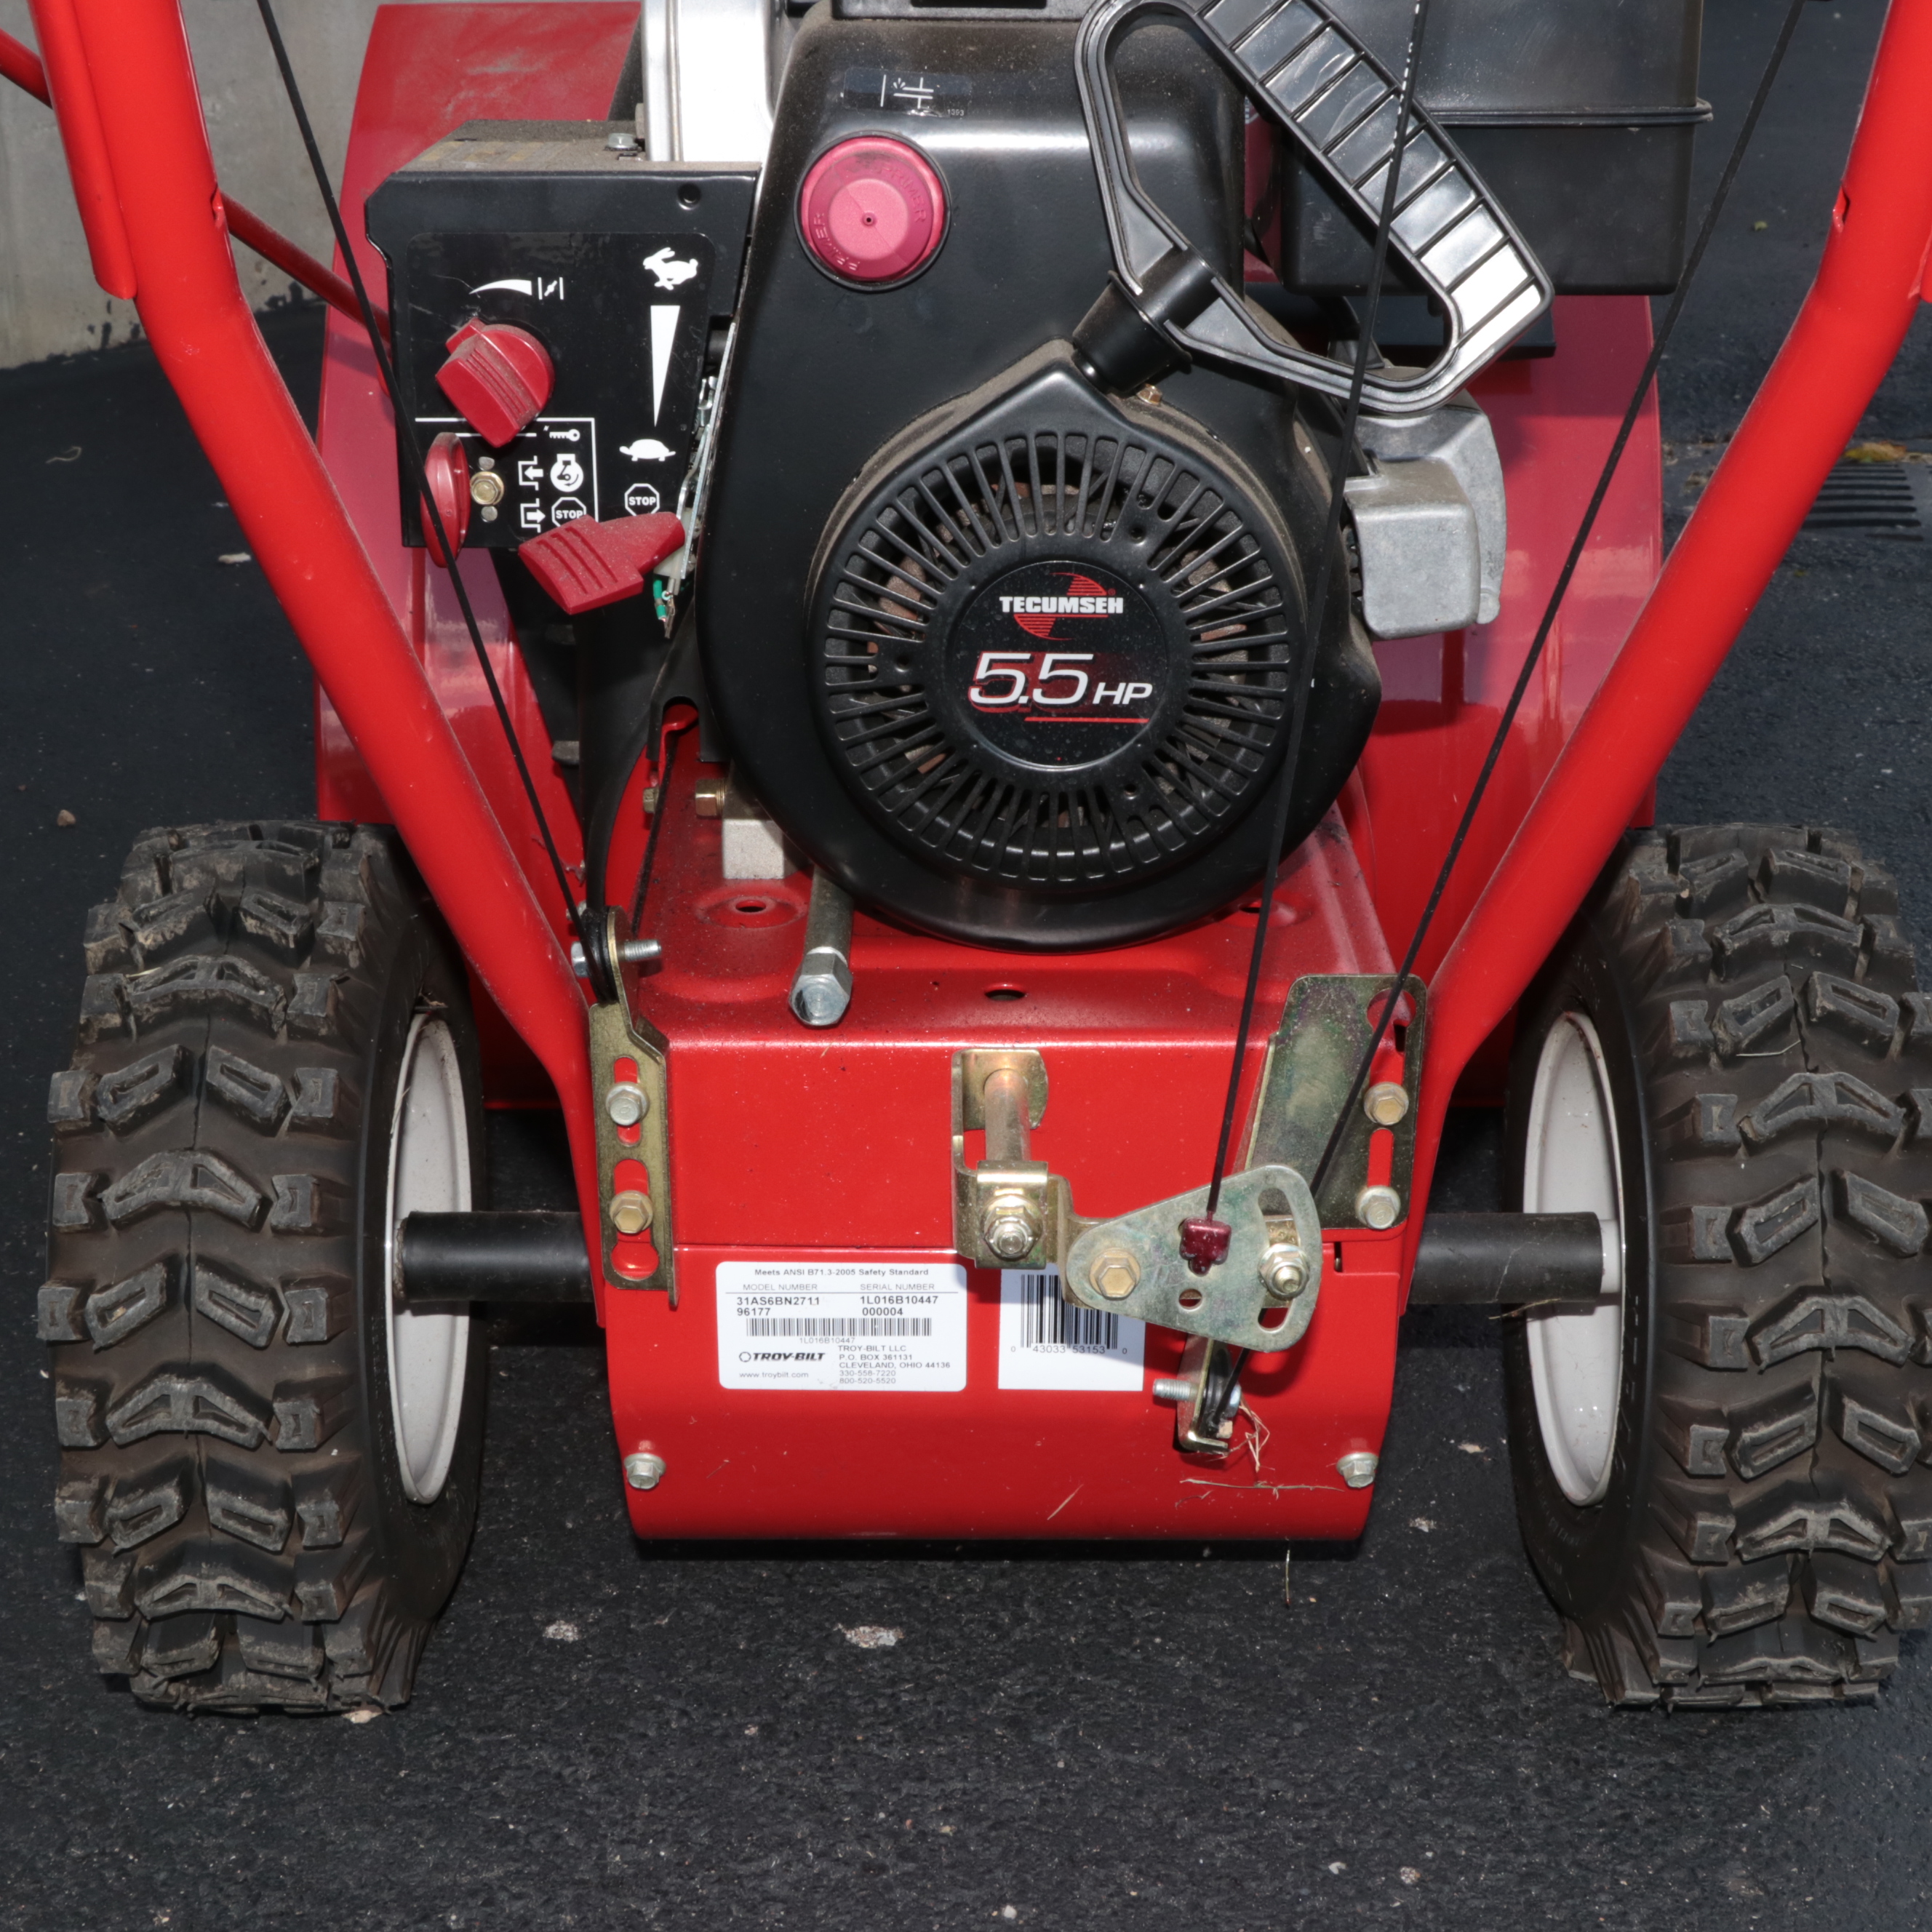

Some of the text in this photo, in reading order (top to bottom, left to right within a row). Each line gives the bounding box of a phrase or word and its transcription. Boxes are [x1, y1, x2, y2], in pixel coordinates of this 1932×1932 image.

[628, 496, 656, 506] STOP
[556, 510, 583, 519] STOP
[999, 596, 1124, 614] TECUMSEH
[970, 652, 1153, 705] 5.5 HP
[807, 1268, 856, 1276] B71.3-2005
[858, 1268, 887, 1278] Safety
[889, 1268, 929, 1276] Standard
[743, 1283, 818, 1291] MODEL NUMBER
[860, 1283, 935, 1291] SERIAL NUMBER
[736, 1296, 820, 1306] 31AS6BN2711
[860, 1295, 939, 1305] 1L016B10447
[736, 1306, 771, 1317] 96177
[861, 1306, 904, 1317] 000004
[799, 1336, 855, 1344] 1L016B10447
[1010, 1345, 1127, 1355] 0 43033 53153 0
[752, 1352, 826, 1362] TROY-BILT
[839, 1361, 951, 1370] CLEVELAND, OHIO 44136
[738, 1370, 810, 1380] www.troybilt.com
